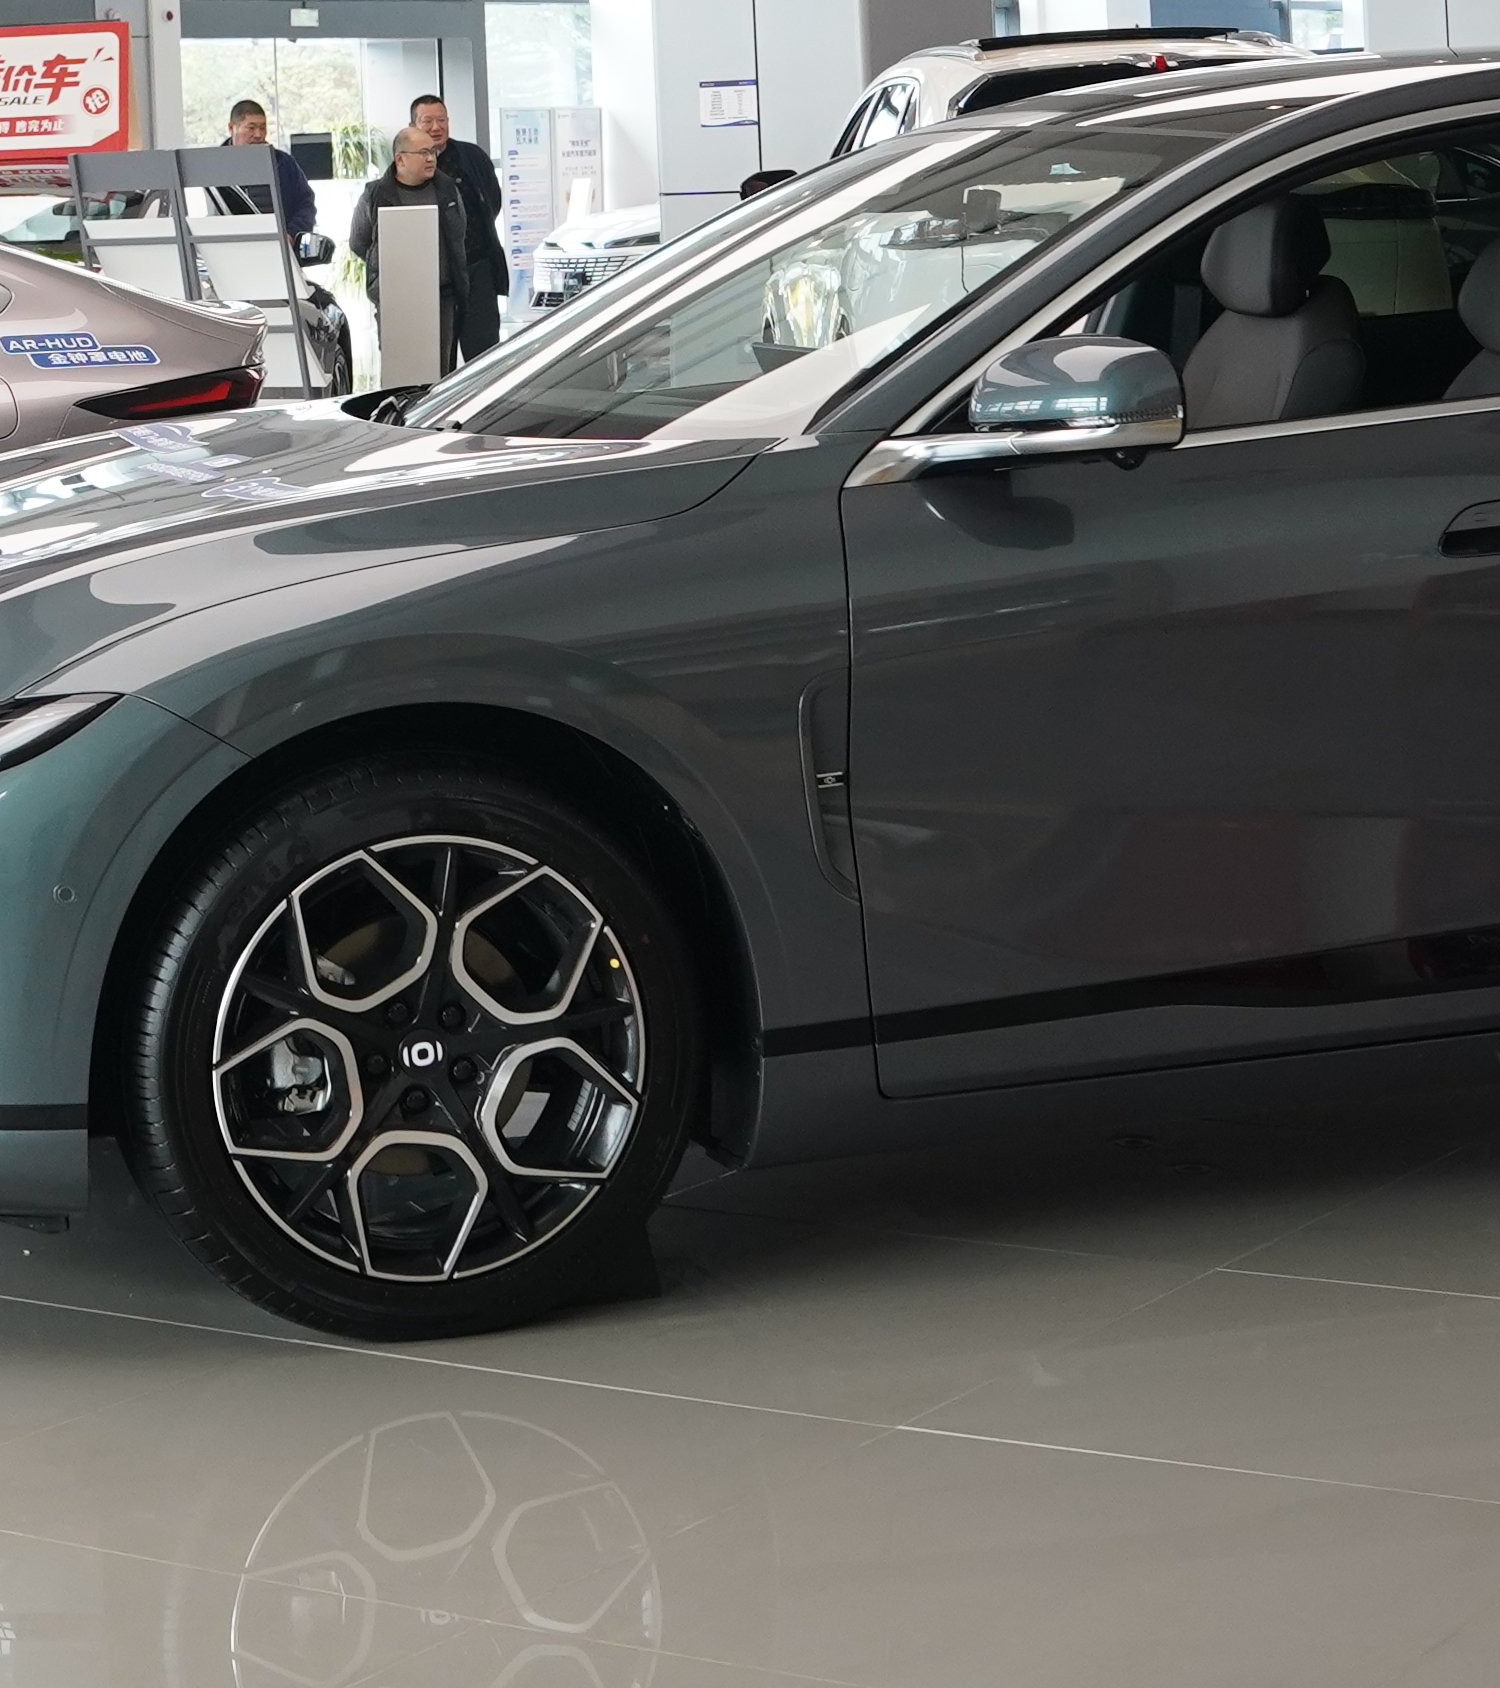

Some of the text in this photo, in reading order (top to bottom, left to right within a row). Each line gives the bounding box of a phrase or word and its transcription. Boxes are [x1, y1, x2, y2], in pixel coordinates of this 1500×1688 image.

[15, 119, 66, 133] 售完为止
[8, 336, 93, 351] AR-HUD
[48, 350, 150, 365] 金钟罩电池
